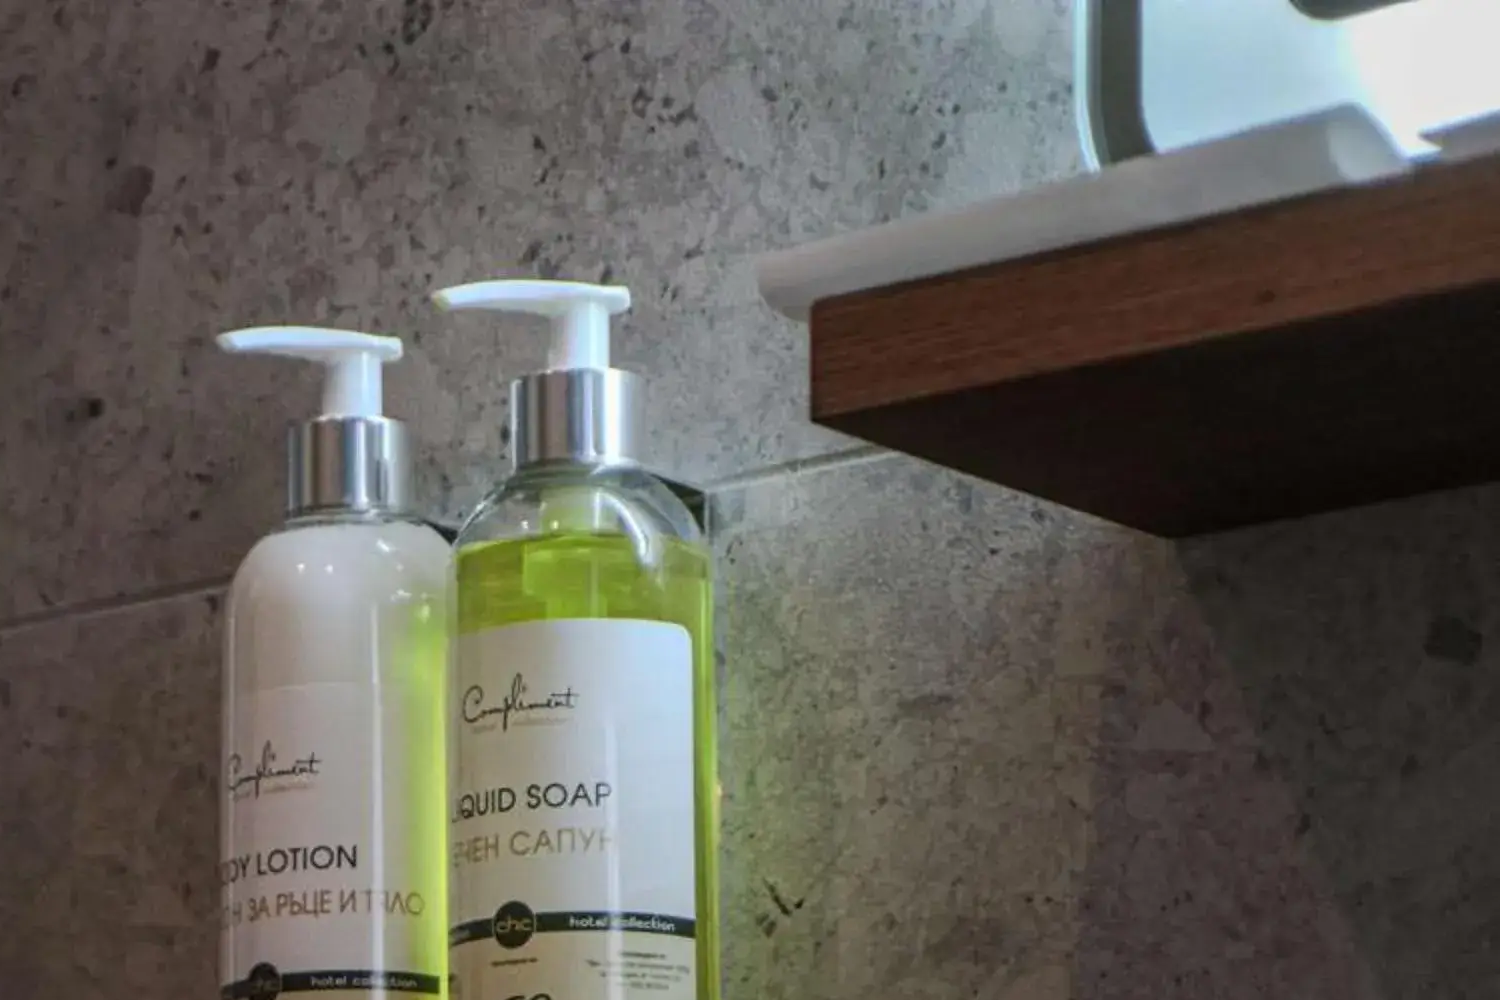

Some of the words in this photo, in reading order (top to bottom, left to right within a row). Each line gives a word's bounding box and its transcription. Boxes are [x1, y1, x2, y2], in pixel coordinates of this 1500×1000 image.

[463, 673, 580, 732] Compliment
[452, 787, 516, 823] QUID
[527, 782, 612, 809] SOAP
[257, 845, 357, 875] LOTION
[248, 896, 270, 922] ЗА
[276, 890, 332, 918] РЪЦЕ
[340, 889, 356, 914] И
[569, 914, 607, 928] hotel
[311, 975, 347, 988] hotel
